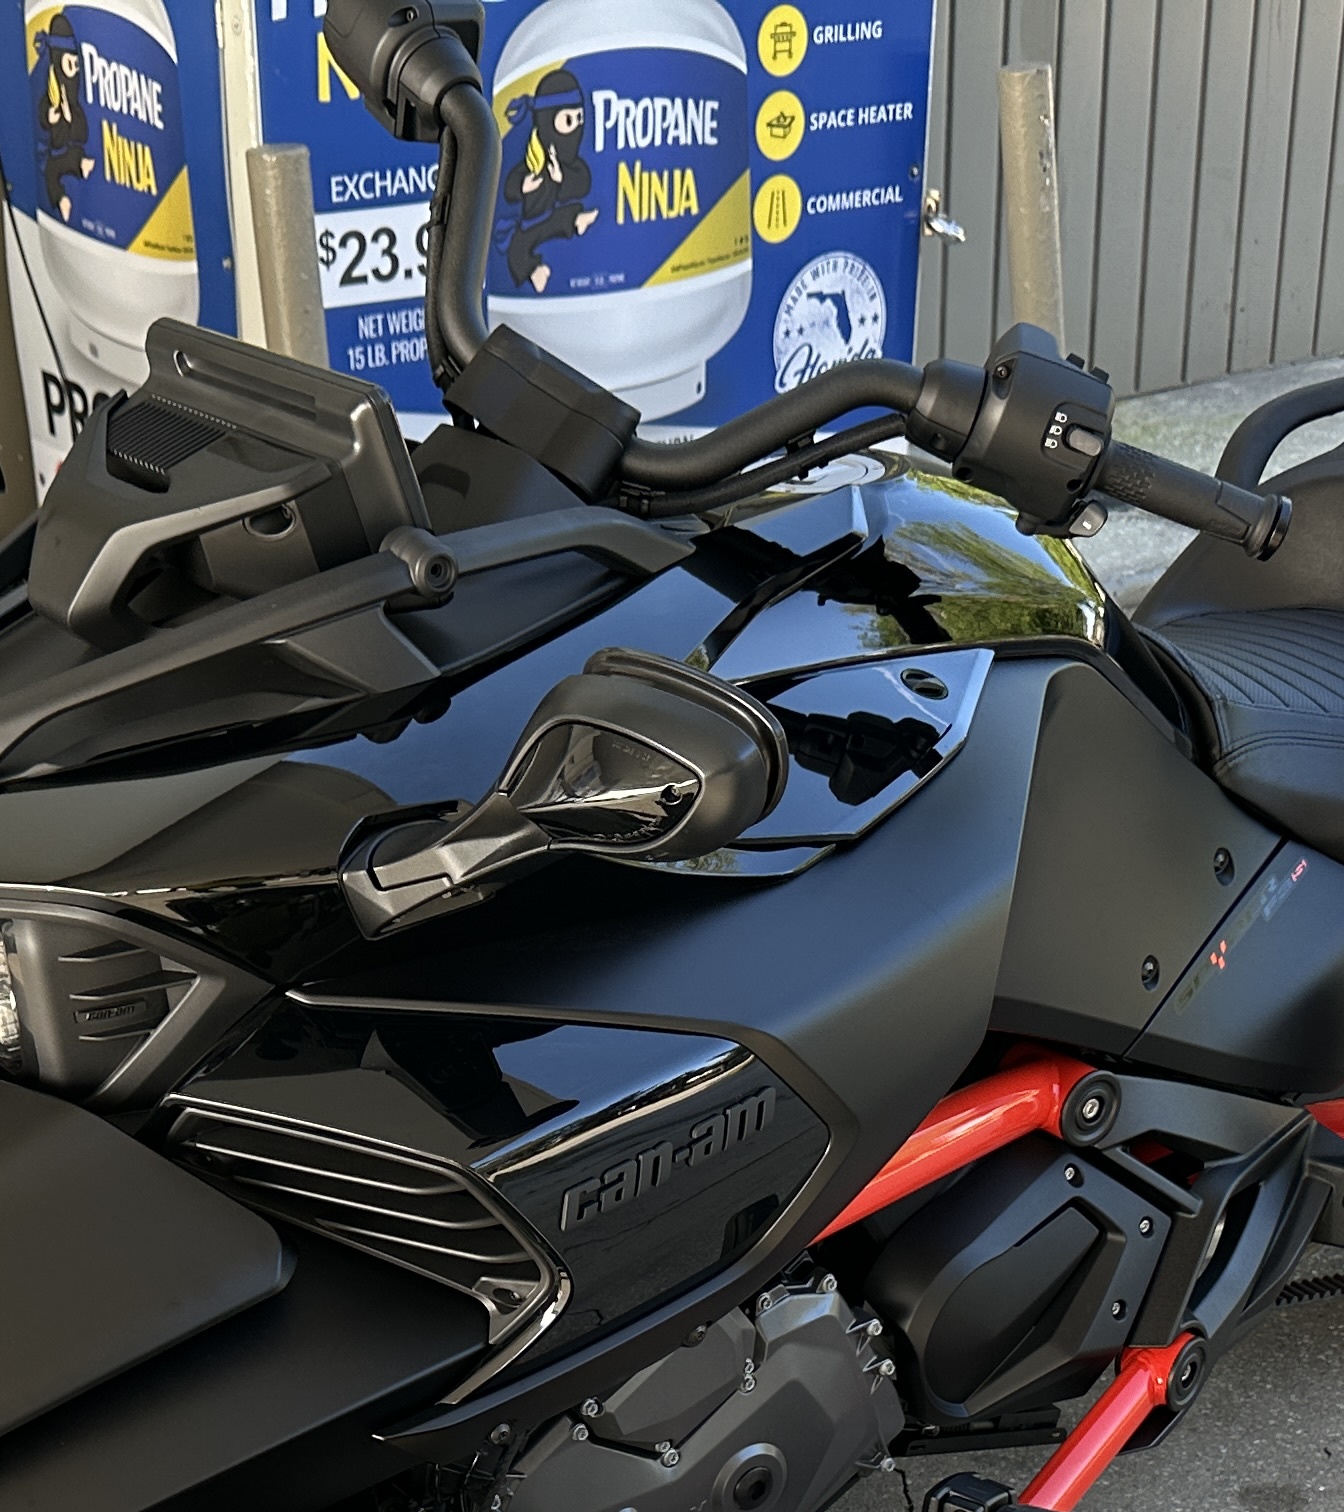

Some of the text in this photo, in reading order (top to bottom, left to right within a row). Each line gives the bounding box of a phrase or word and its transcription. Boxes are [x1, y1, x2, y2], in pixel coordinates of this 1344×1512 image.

[812, 20, 883, 45] GRILLING
[81, 41, 164, 130] PROPANE
[592, 89, 719, 153] PROPANE
[809, 101, 914, 132] SPACE HEATER
[102, 119, 158, 196] NINJA
[615, 159, 699, 225] NINJA
[806, 184, 904, 216] COMMERCIAL
[357, 307, 426, 340] NET WEIG
[347, 347, 365, 372] 15
[367, 341, 389, 370] LB.
